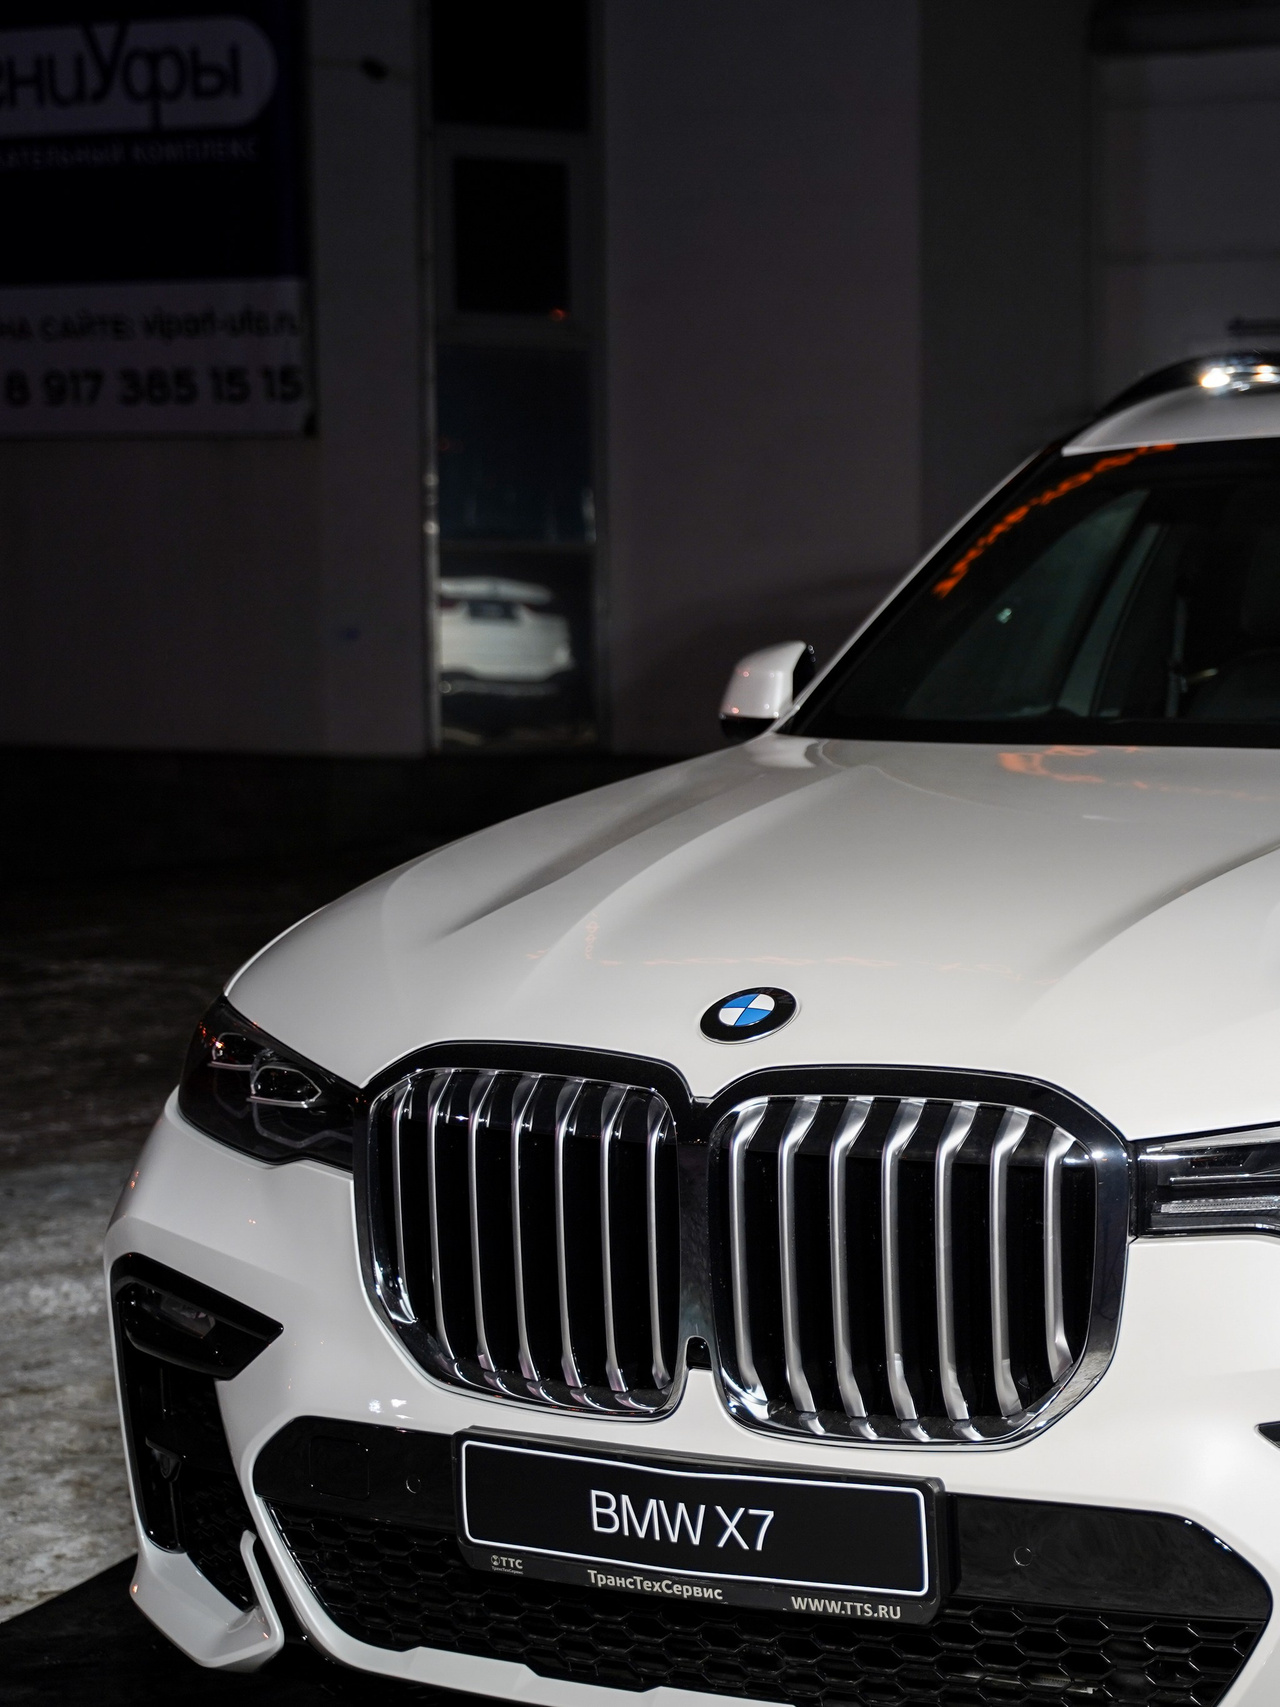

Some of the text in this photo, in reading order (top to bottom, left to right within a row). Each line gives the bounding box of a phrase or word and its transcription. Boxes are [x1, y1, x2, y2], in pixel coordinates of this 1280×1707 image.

[0, 22, 242, 131] ниУфы
[0, 140, 126, 169] АТЕЛЬНЫЙ
[4, 363, 302, 408] 8 917 385 15 15
[589, 1488, 775, 1552] BMW X7
[500, 1556, 523, 1570] ТТС
[587, 1569, 723, 1601] ТрансТехСервис
[791, 1596, 902, 1621] WWW.TTS.RU
